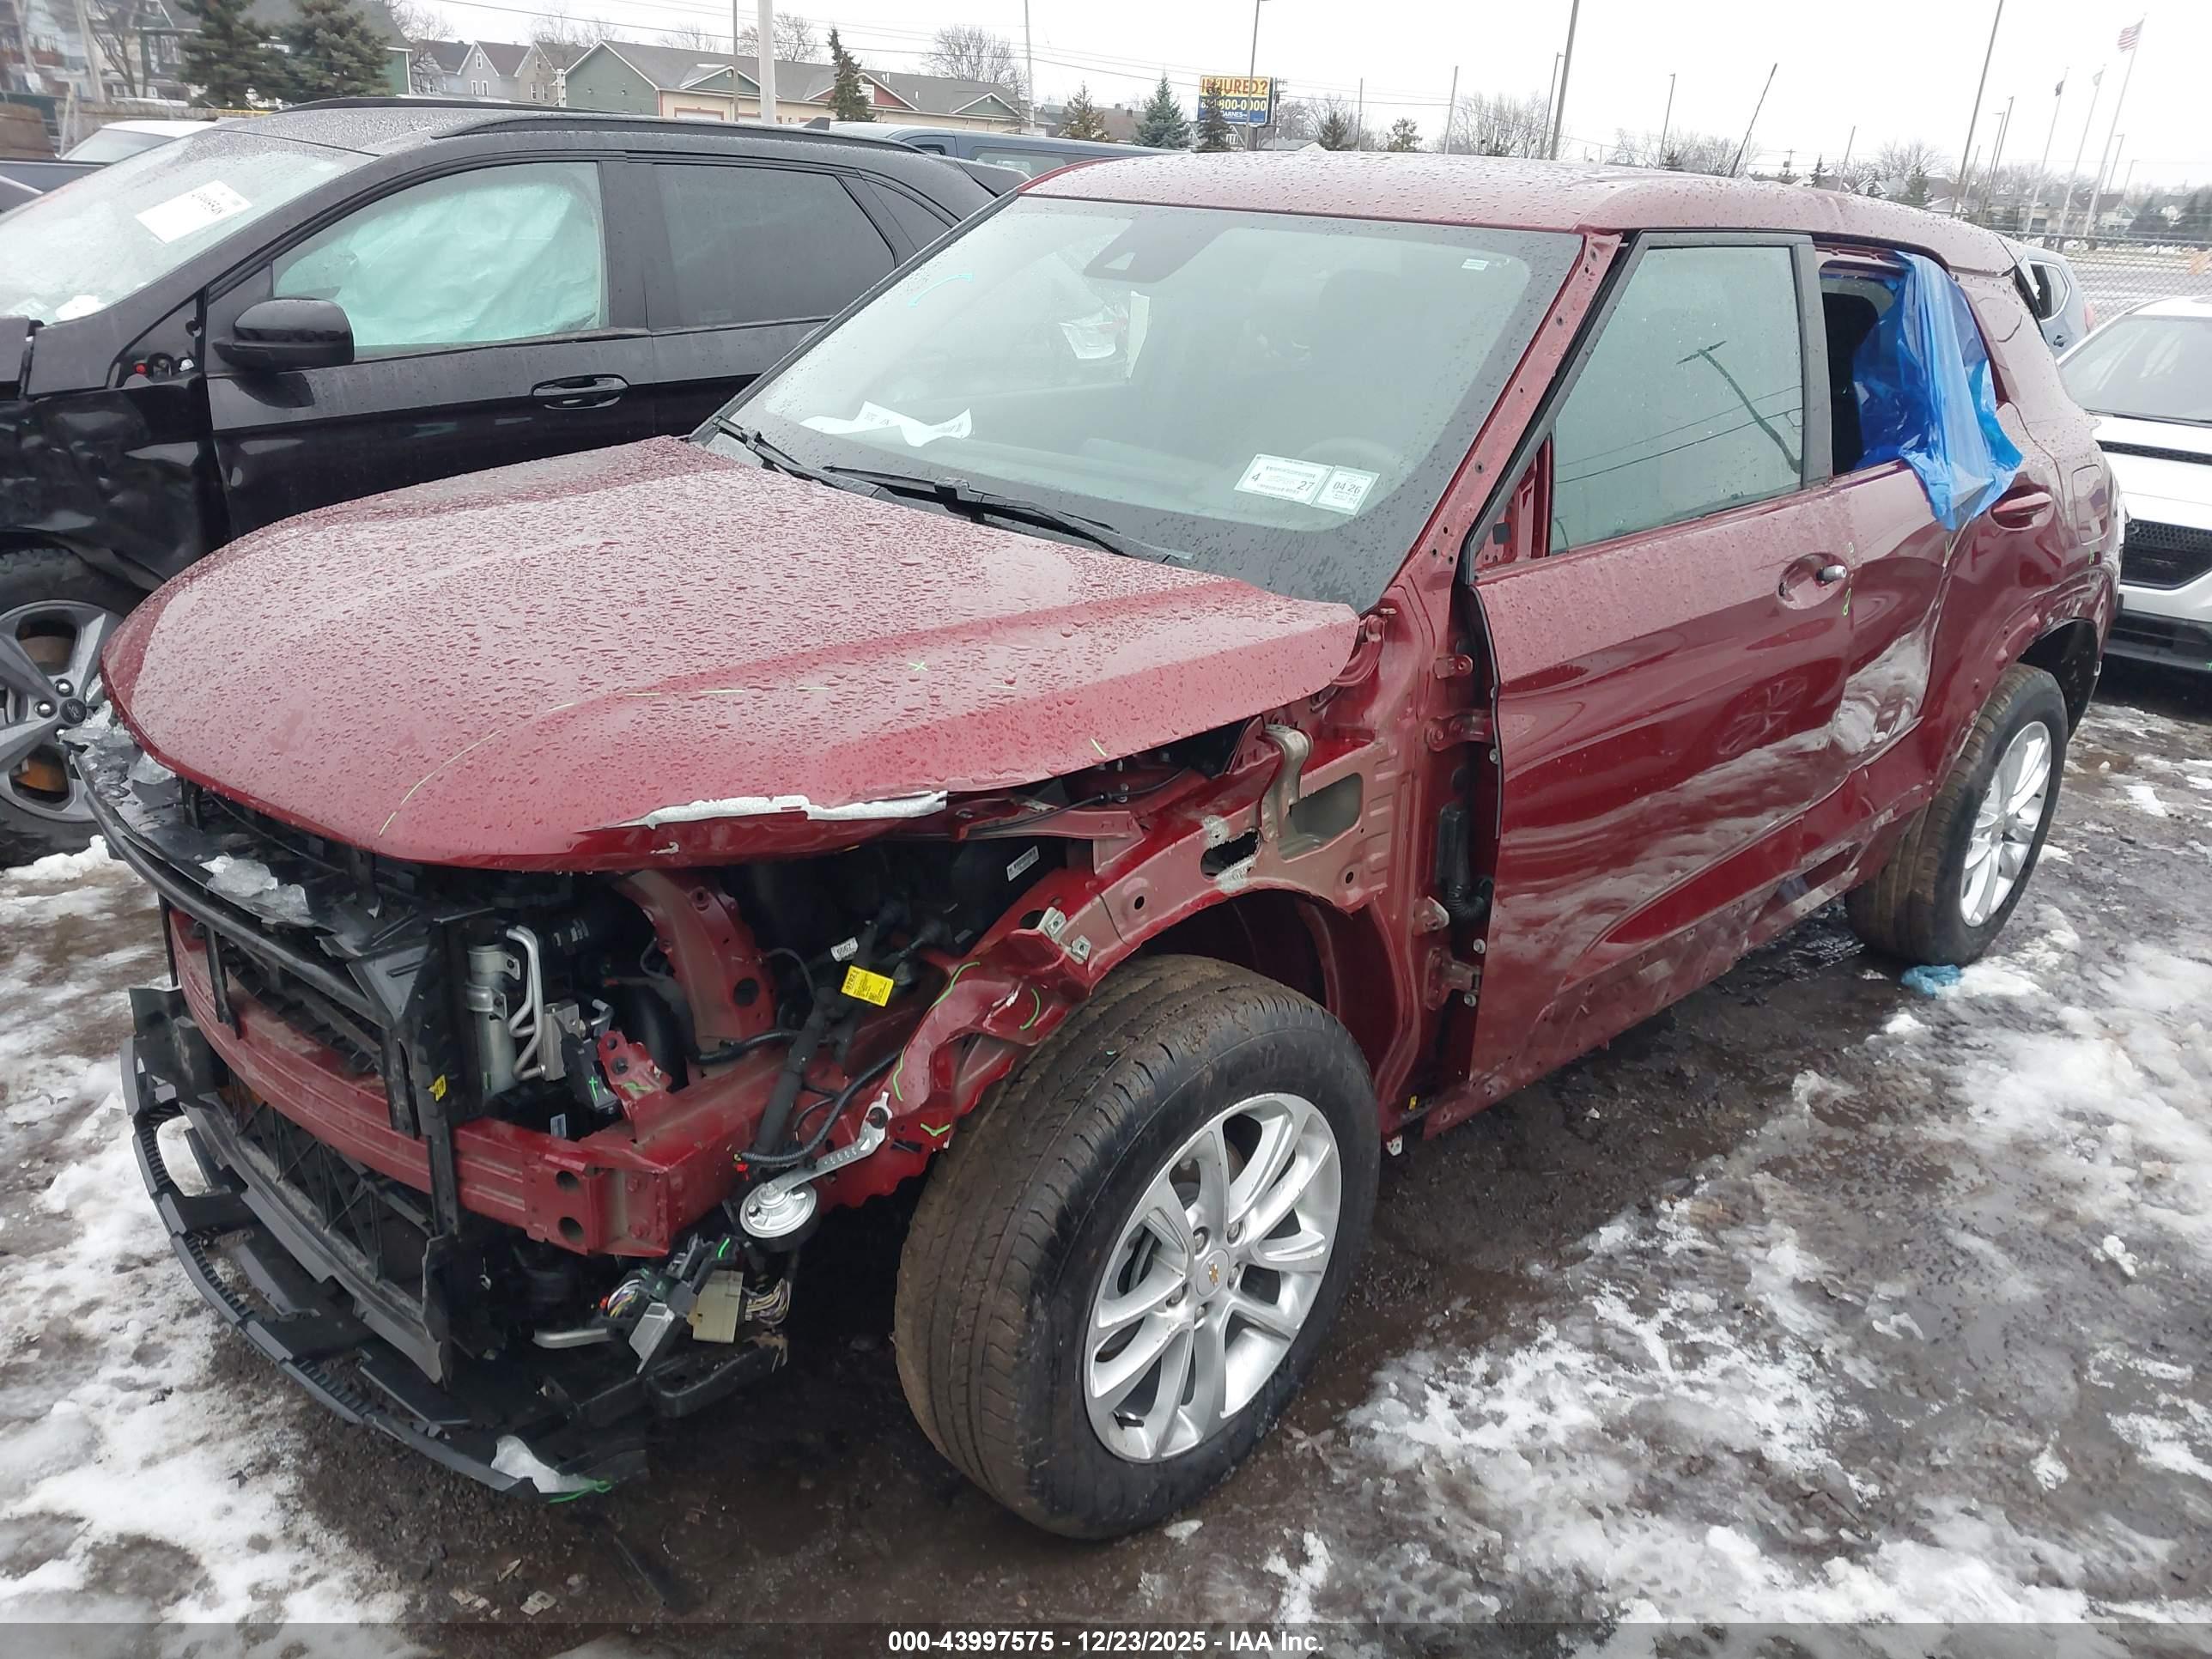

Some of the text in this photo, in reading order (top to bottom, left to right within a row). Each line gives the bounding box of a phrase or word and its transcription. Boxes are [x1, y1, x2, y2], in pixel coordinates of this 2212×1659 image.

[1251, 472, 1261, 482] 4
[1297, 480, 1316, 492] 27
[1347, 483, 1362, 494] 26
